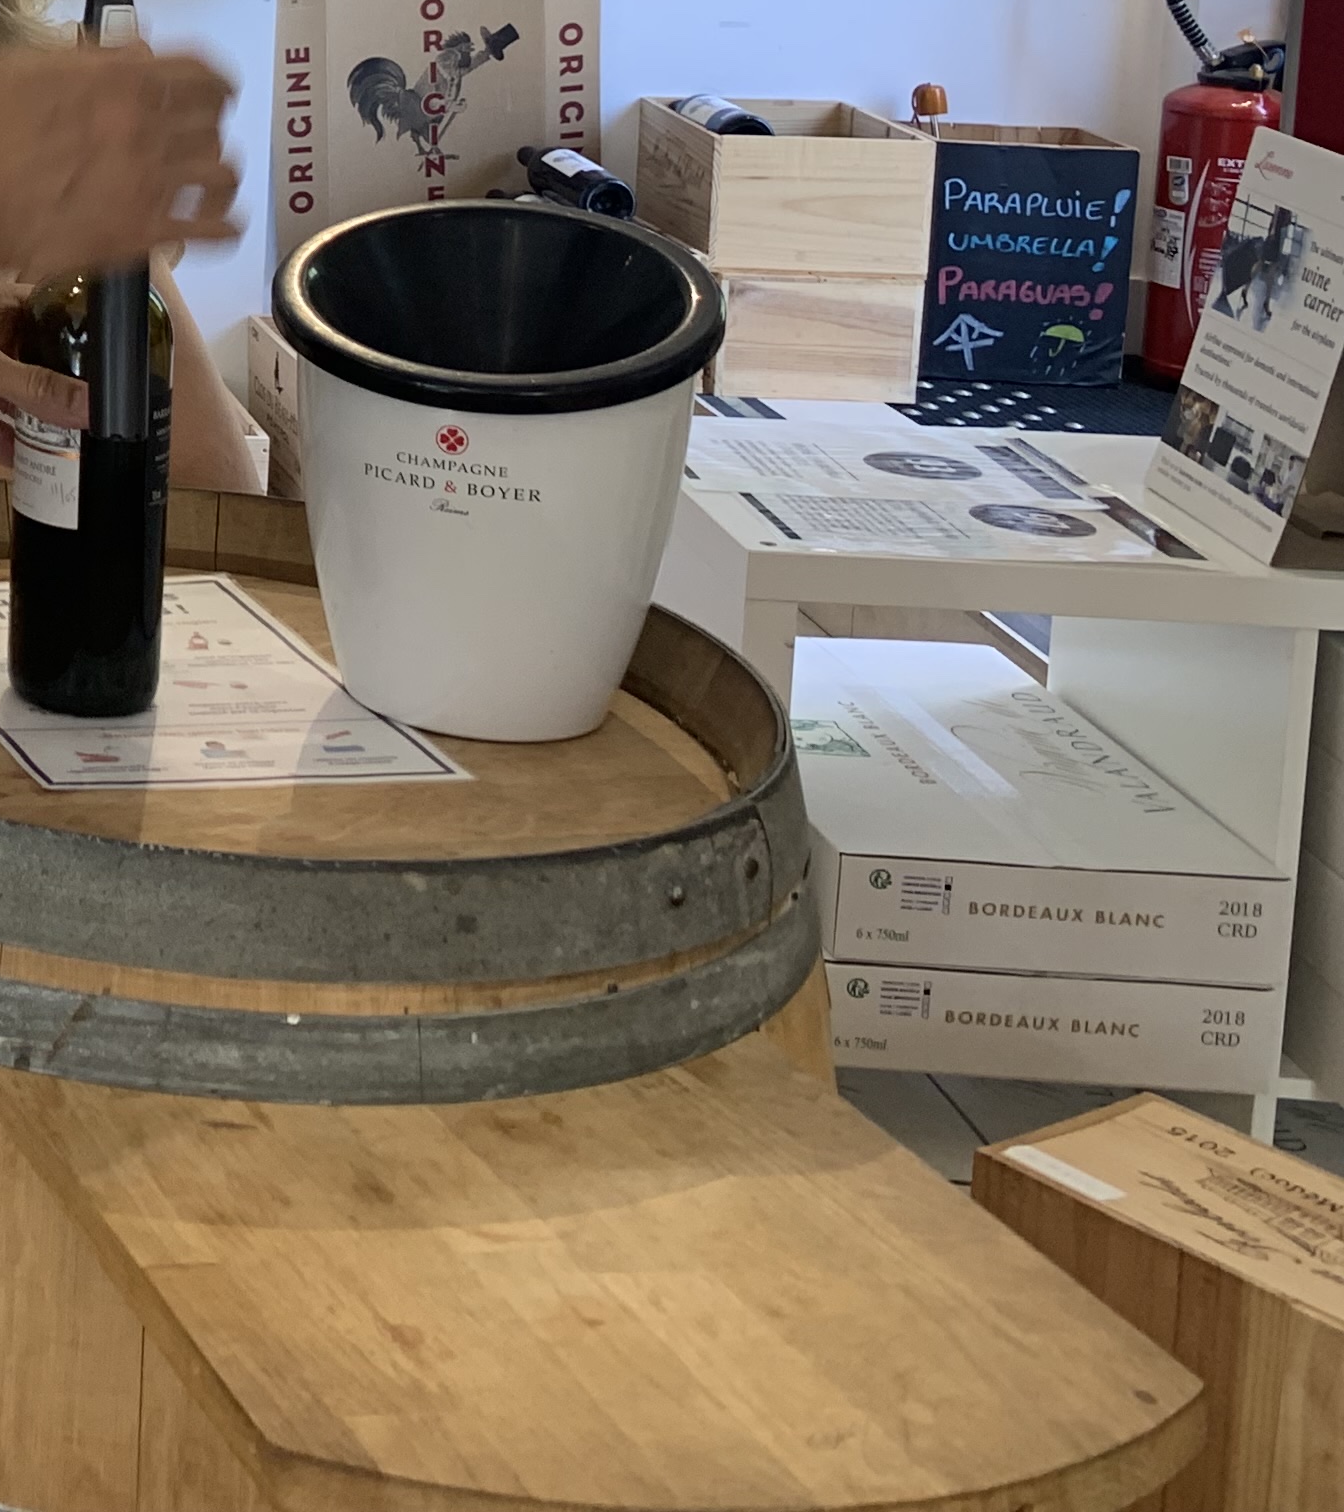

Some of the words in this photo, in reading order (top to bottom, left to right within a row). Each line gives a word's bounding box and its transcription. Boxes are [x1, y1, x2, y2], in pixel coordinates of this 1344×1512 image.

[558, 22, 585, 154] ORIGI
[285, 46, 315, 214] ORIGINE
[1301, 266, 1331, 292] wine
[1303, 291, 1344, 323] carrier
[395, 451, 509, 479] CHAMPAGNE
[363, 463, 436, 490] PICARD
[443, 479, 457, 494] &
[467, 482, 542, 503] BOYER
[1011, 690, 1176, 815] VALANDRAUD
[968, 901, 1085, 924] BORDEAUX
[1095, 910, 1165, 929] BLANC
[1217, 900, 1263, 919] 2018
[856, 928, 864, 940] 6
[866, 931, 873, 940] x
[875, 927, 910, 943] 750ml
[1217, 921, 1258, 939] CRD
[944, 1009, 1060, 1033] BORDEAUX
[1070, 1017, 1140, 1038] BLANC
[1201, 1008, 1246, 1026] 2018
[833, 1035, 841, 1048] 6
[844, 1039, 851, 1048] x
[854, 1035, 888, 1052] 750ml
[1200, 1029, 1240, 1048] CRD
